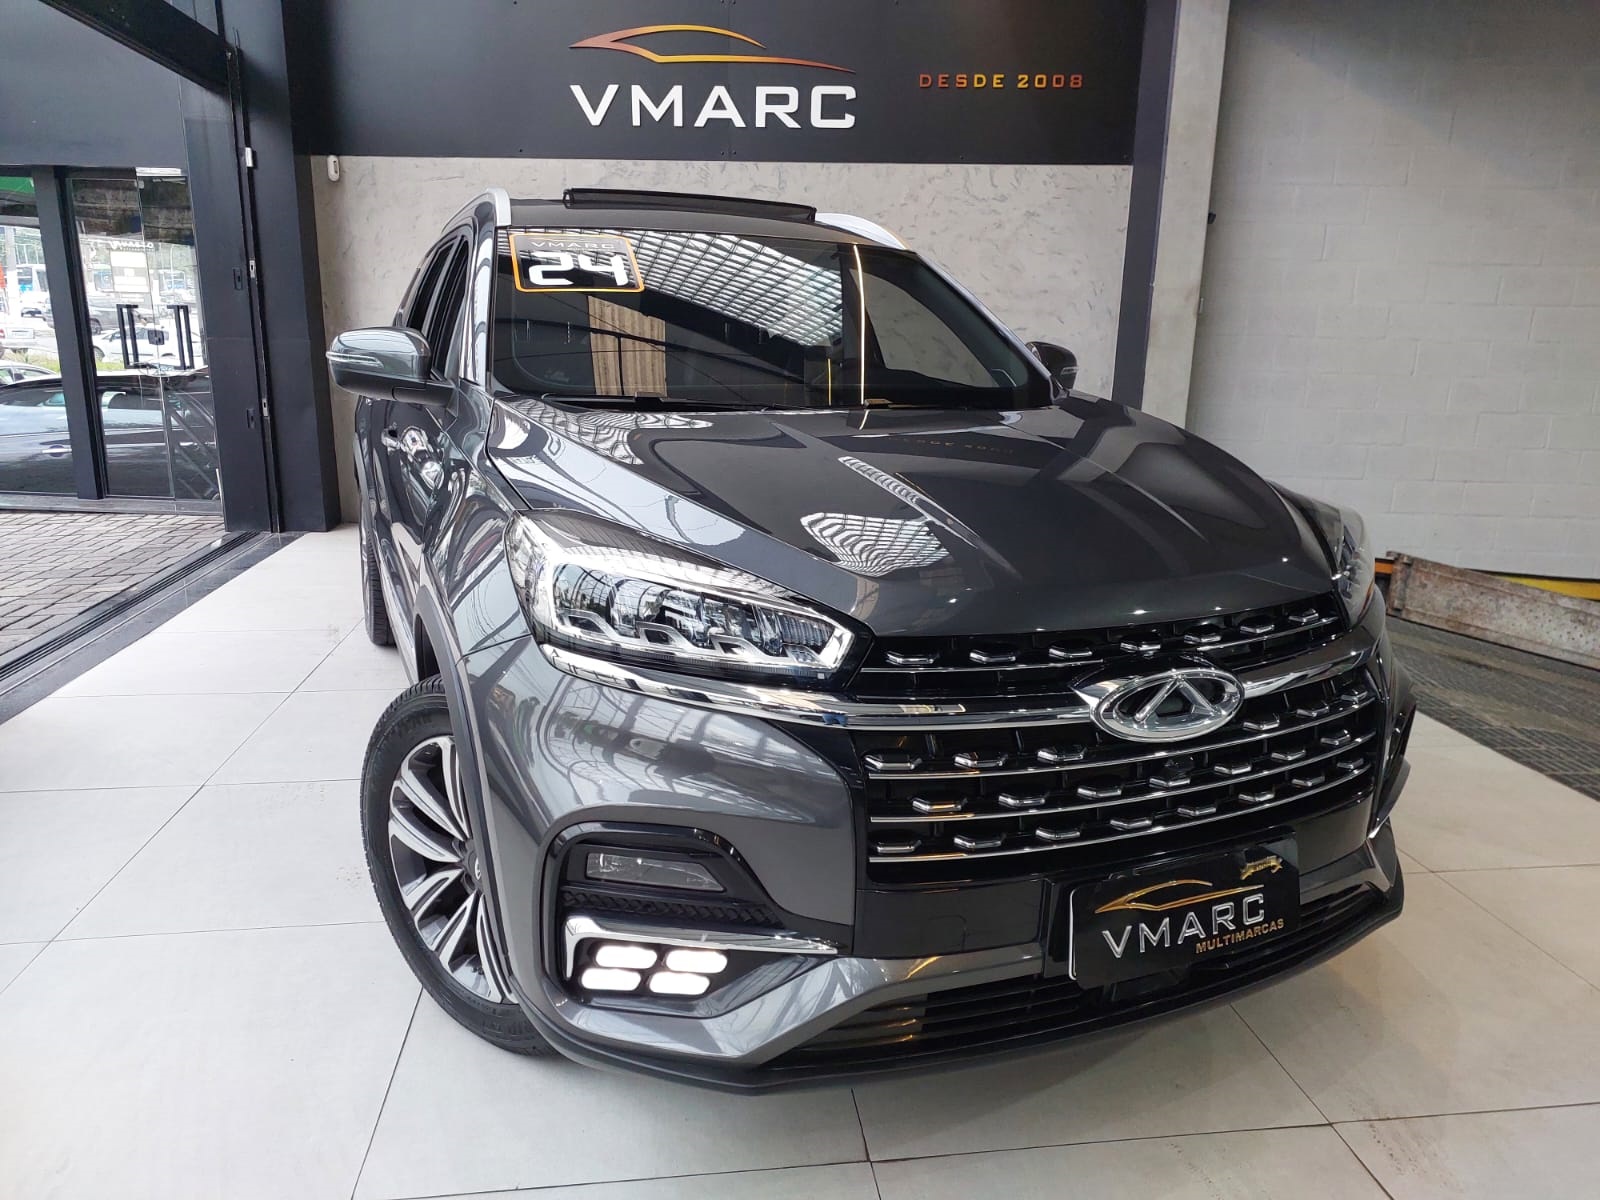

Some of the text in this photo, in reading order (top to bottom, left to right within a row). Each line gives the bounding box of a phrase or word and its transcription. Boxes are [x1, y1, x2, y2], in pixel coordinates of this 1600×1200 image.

[919, 73, 1084, 91] DESDE 2008
[569, 84, 857, 128] VMARC
[531, 241, 614, 249] VMARC
[528, 251, 629, 286] 24
[1102, 893, 1265, 959] VMARC
[1195, 918, 1285, 954] MULTIMARCAS
